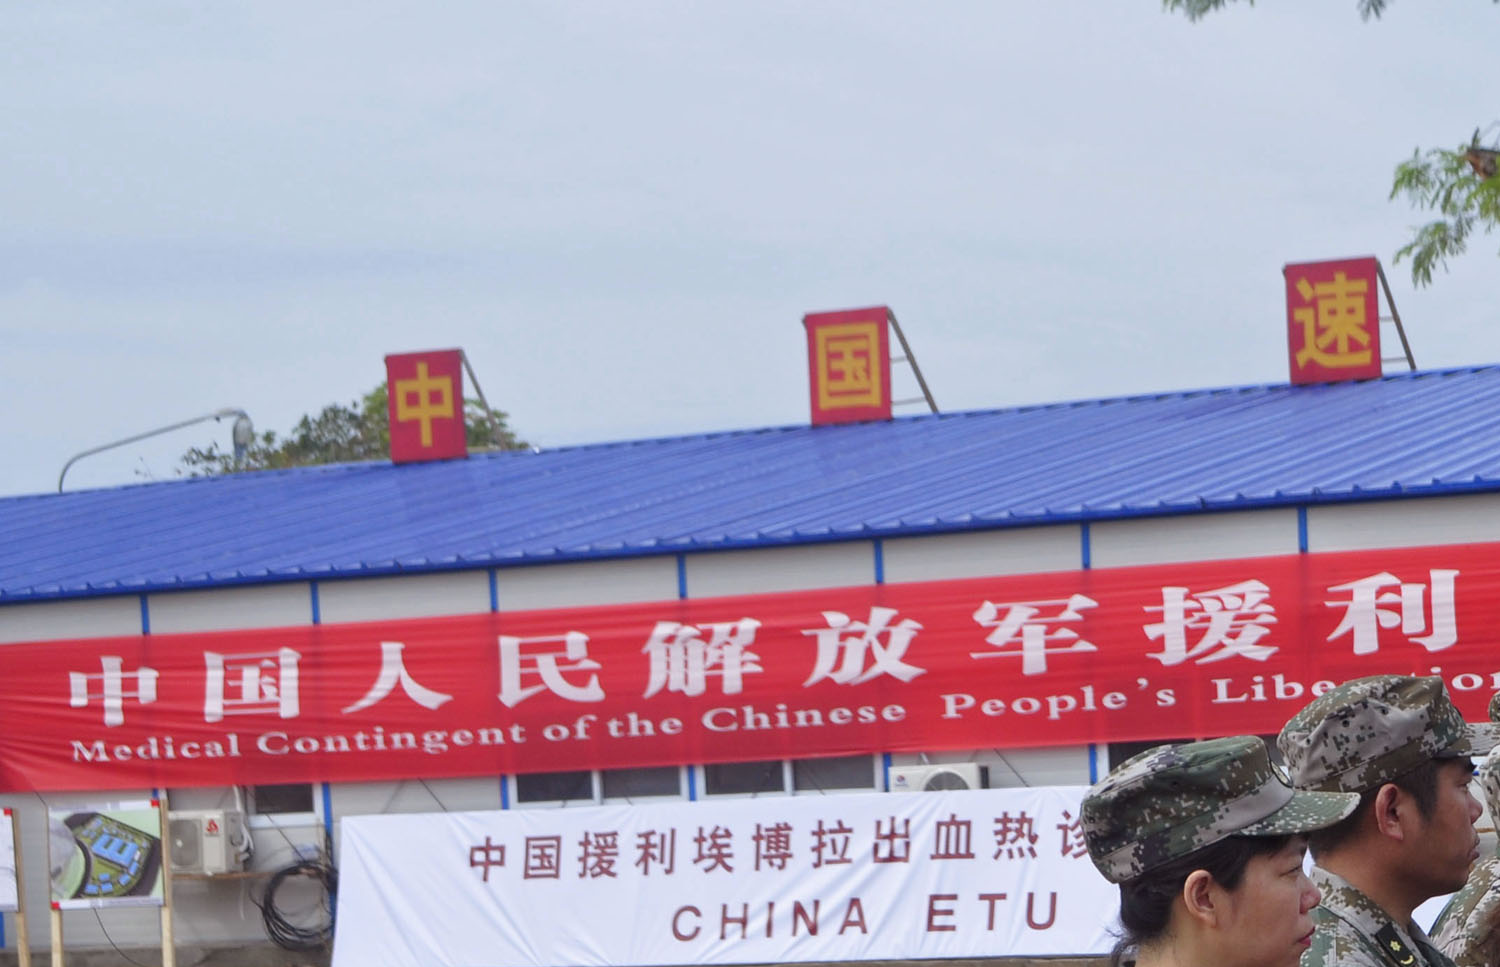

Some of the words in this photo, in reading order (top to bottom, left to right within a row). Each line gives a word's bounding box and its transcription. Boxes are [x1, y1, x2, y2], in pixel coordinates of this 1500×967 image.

[1293, 271, 1372, 369] 速
[396, 362, 454, 448] 中
[815, 322, 882, 410] 国
[70, 733, 242, 763] Medical
[256, 723, 527, 755] Contingent
[543, 714, 598, 742] of
[607, 712, 683, 738] the
[702, 703, 906, 732] Chinese
[671, 896, 869, 942] CHINA
[926, 891, 1058, 932] ETU
